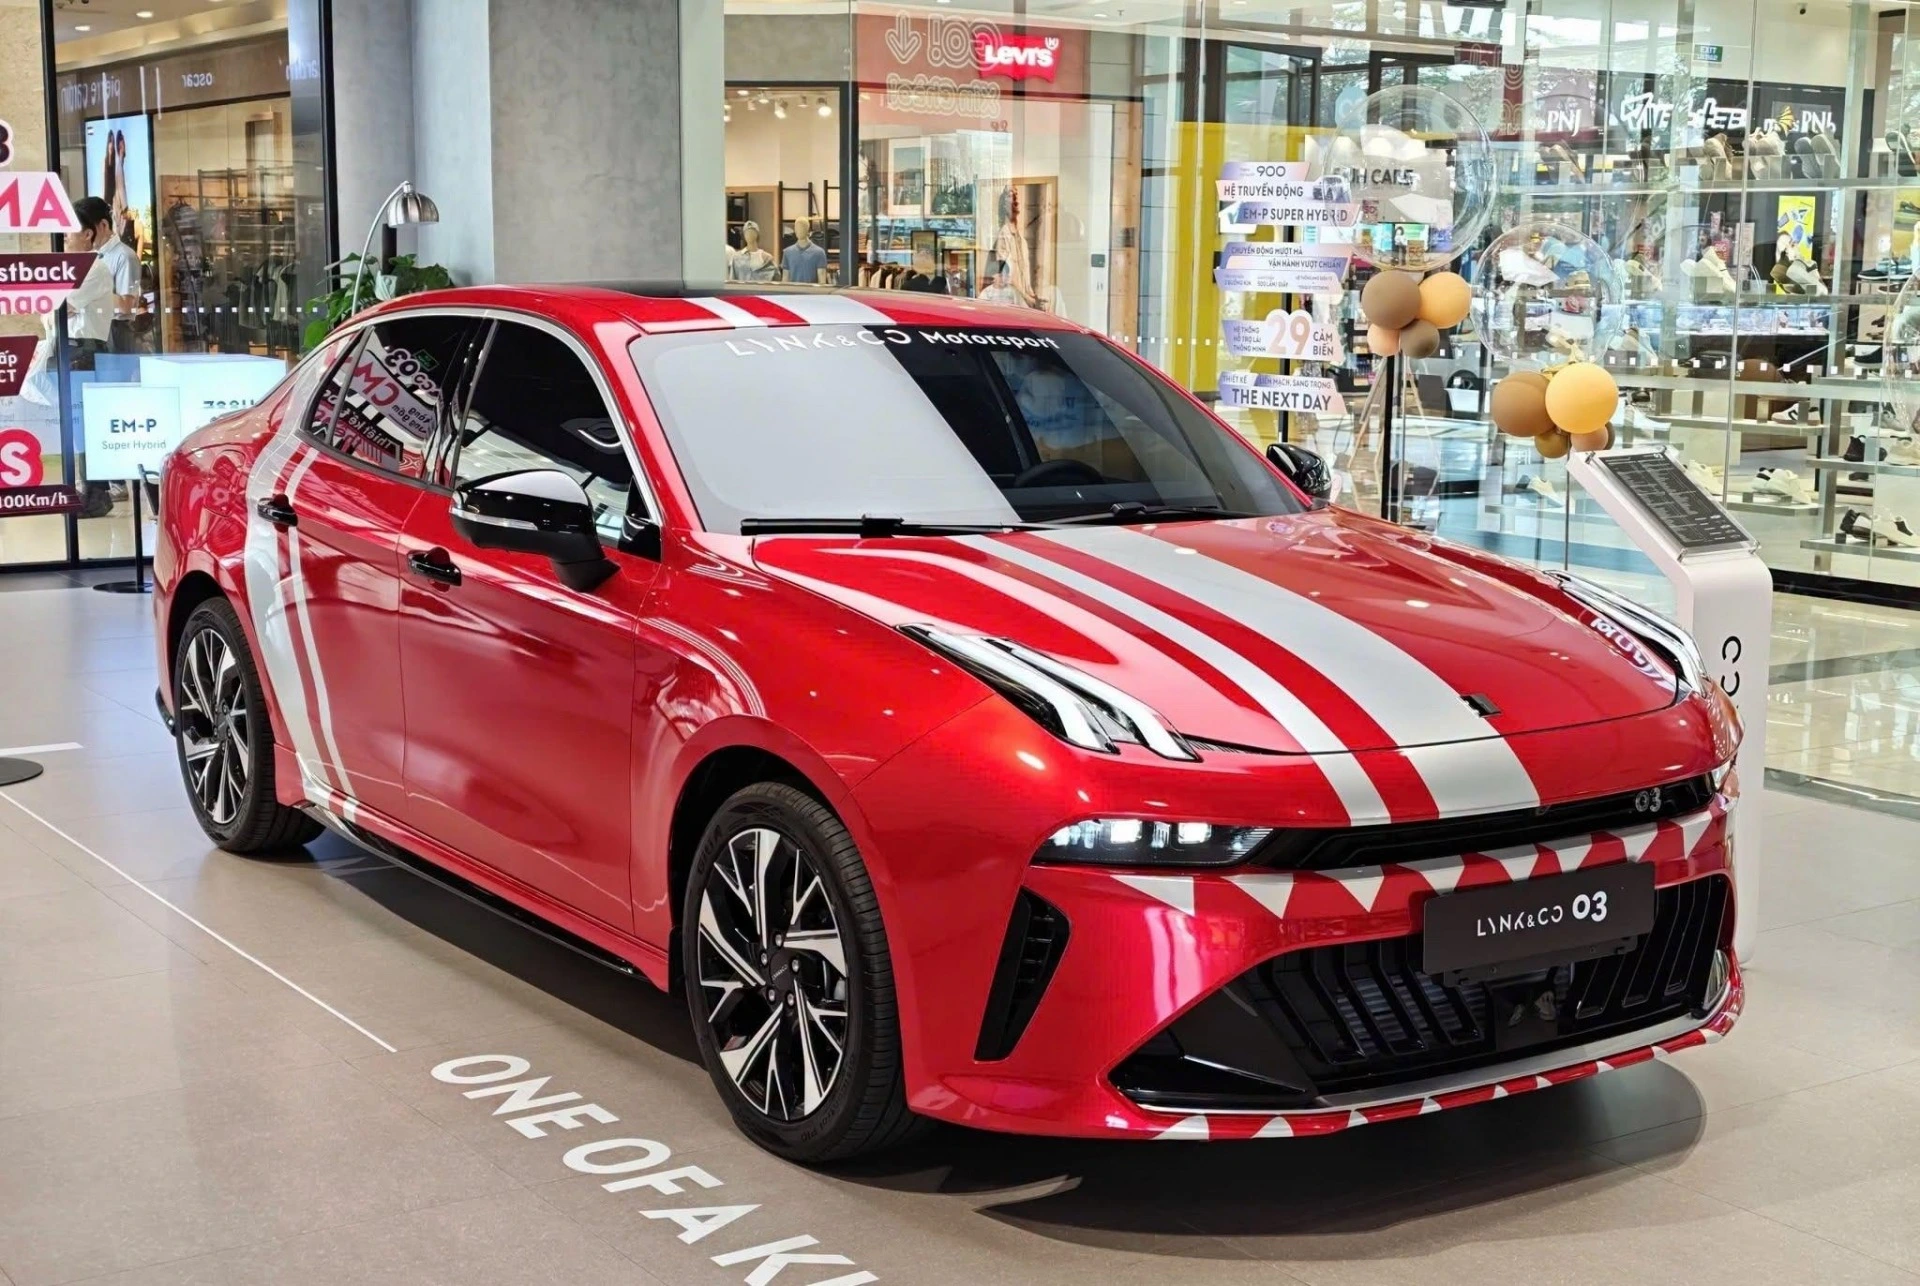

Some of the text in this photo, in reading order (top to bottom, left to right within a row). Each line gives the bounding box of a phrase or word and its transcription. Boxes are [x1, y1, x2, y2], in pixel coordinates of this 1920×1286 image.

[1256, 165, 1286, 177] 900
[1243, 208, 1268, 220] EM-P
[1270, 208, 1304, 221] SUPER
[918, 330, 1060, 350] Motorsport
[1268, 314, 1311, 355] 29
[1232, 388, 1331, 411] THE NEXT DAY
[110, 418, 157, 433] EM-P
[102, 438, 167, 451] Super Hybrid
[1635, 787, 1662, 813] 03
[1571, 890, 1608, 922] 03
[430, 1054, 621, 1140] ONE
[561, 1138, 725, 1196] OF
[638, 1203, 763, 1245] A
